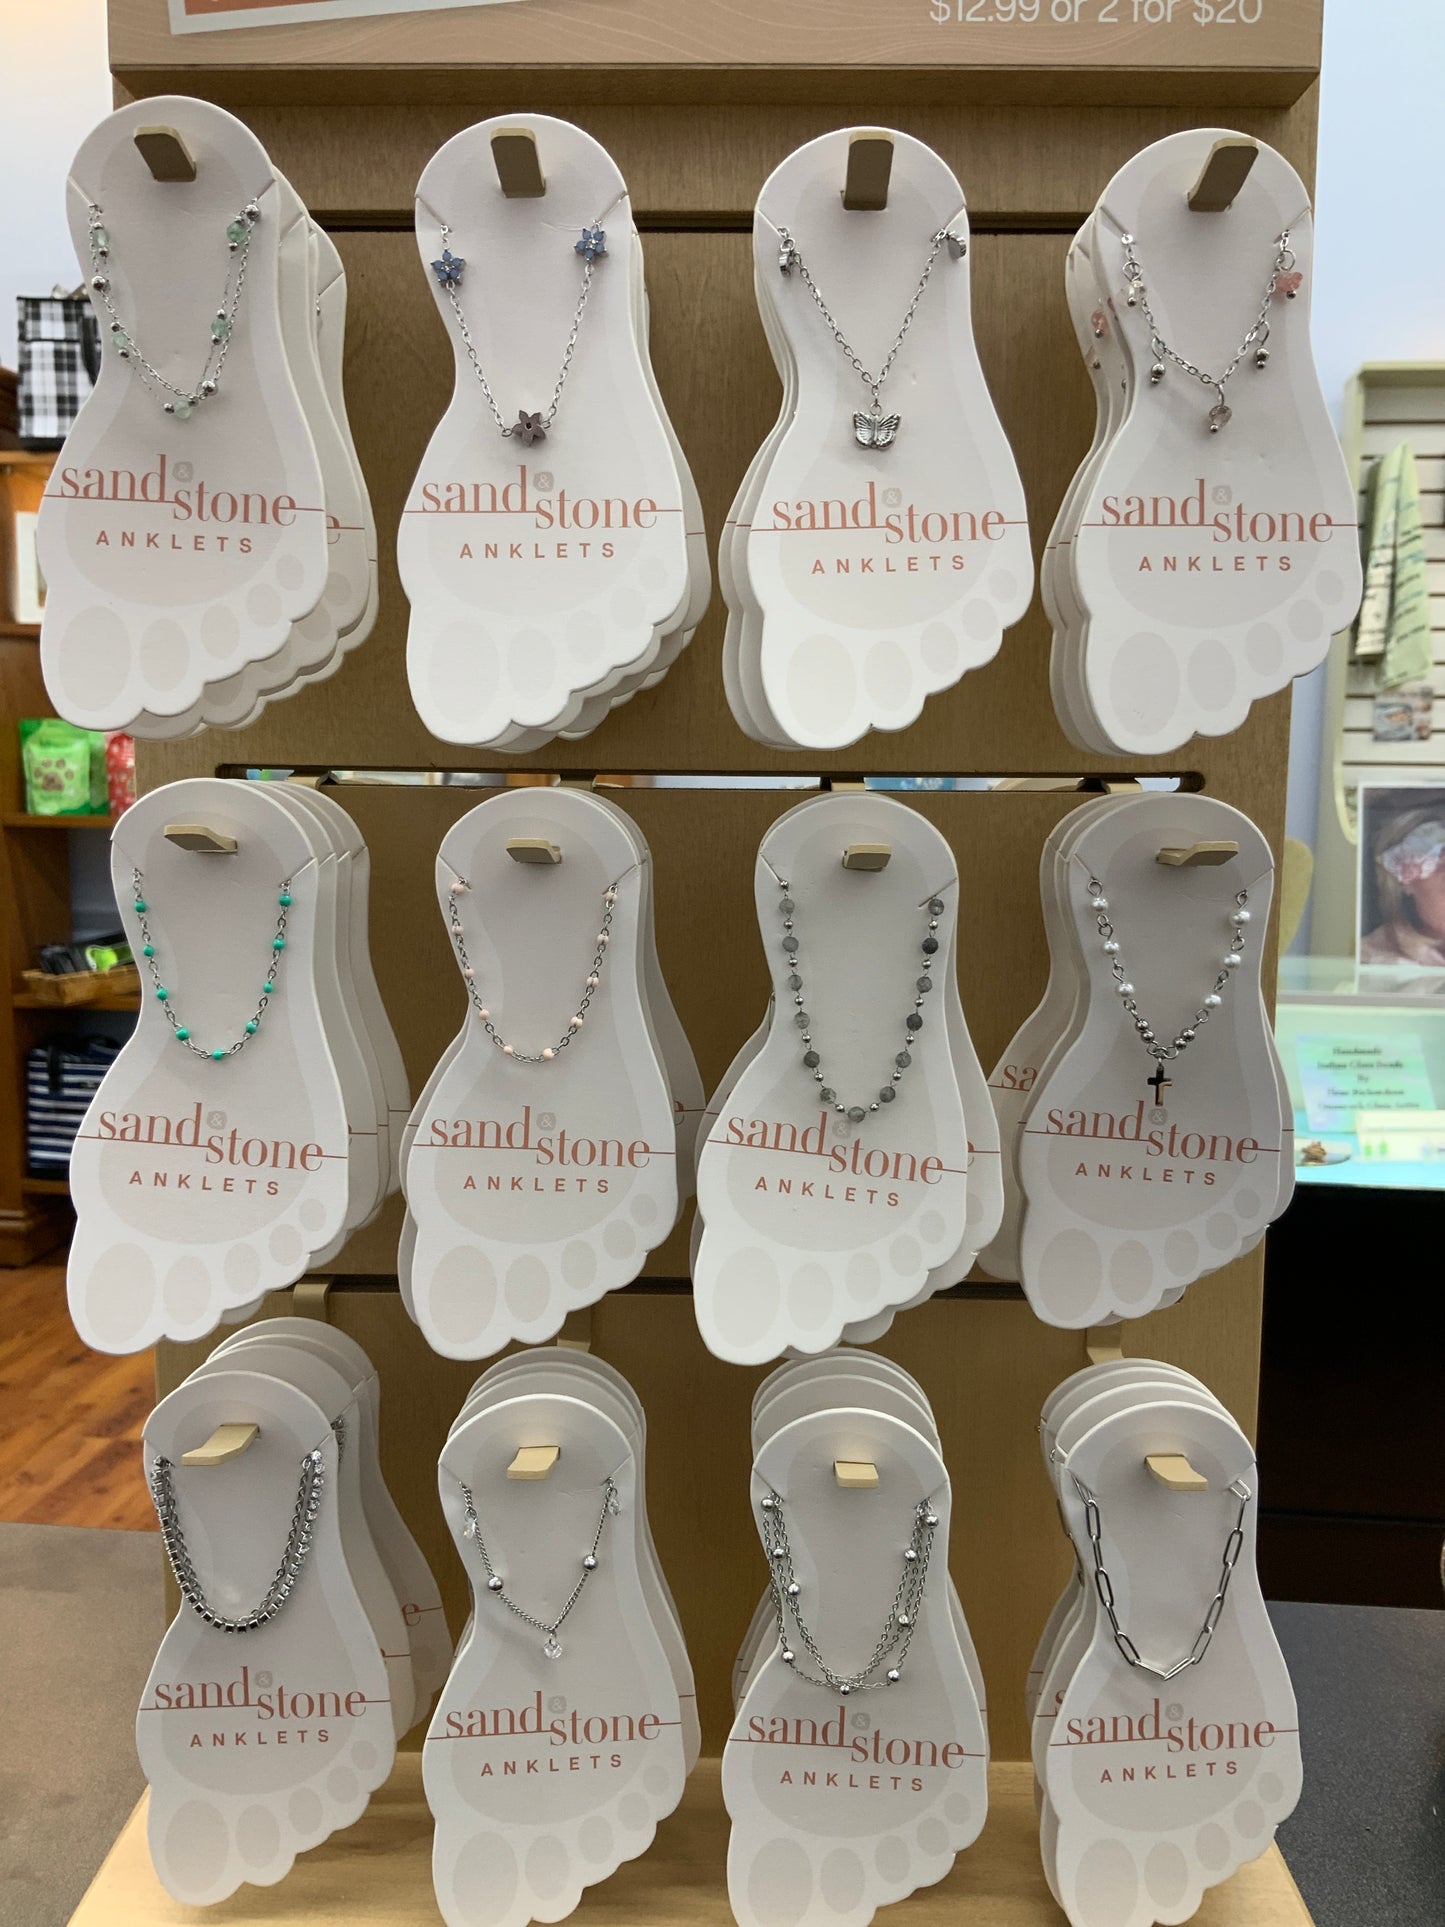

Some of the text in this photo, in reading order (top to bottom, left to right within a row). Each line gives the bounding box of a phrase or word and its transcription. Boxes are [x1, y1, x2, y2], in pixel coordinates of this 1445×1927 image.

[930, 0, 1263, 27] $12.99 or 2 for $20
[60, 454, 166, 500] sand
[173, 480, 297, 526] stone
[422, 465, 527, 513] sand
[535, 489, 657, 529] stone
[773, 481, 876, 530] sand
[885, 504, 1005, 544] stone
[1102, 479, 1205, 526] sand
[1213, 503, 1333, 543] stone
[96, 530, 252, 553] ANKLETS
[460, 543, 615, 559] ANKLETS
[812, 555, 964, 574] ANKLETS
[1139, 556, 1291, 572] ANKLETS
[1001, 1065, 1037, 1091] sa
[99, 1102, 203, 1147] sand
[205, 1128, 323, 1171] stone
[430, 1105, 531, 1149] sand
[536, 1129, 650, 1168] stone
[1046, 1100, 1144, 1141] sand
[1147, 1123, 1258, 1163] stone
[726, 1111, 827, 1155] sand
[829, 1138, 943, 1184] stone
[129, 1170, 279, 1195] ANKLETS
[464, 1175, 609, 1193] ANKLETS
[1075, 1162, 1215, 1185] ANKLETS
[755, 1176, 899, 1206] ANKLETS
[155, 1666, 249, 1709] sand
[257, 1685, 366, 1720] stone
[446, 1691, 542, 1737] sand
[550, 1709, 660, 1746] stone
[1067, 1698, 1159, 1744] sand
[1167, 1716, 1275, 1752] stone
[190, 1729, 329, 1747] ANKLETS
[749, 1705, 845, 1747] sand
[851, 1729, 964, 1769] stone
[481, 1754, 622, 1777] ANKLETS
[1100, 1761, 1238, 1783] ANKLETS
[780, 1771, 922, 1791] ANKLETS
